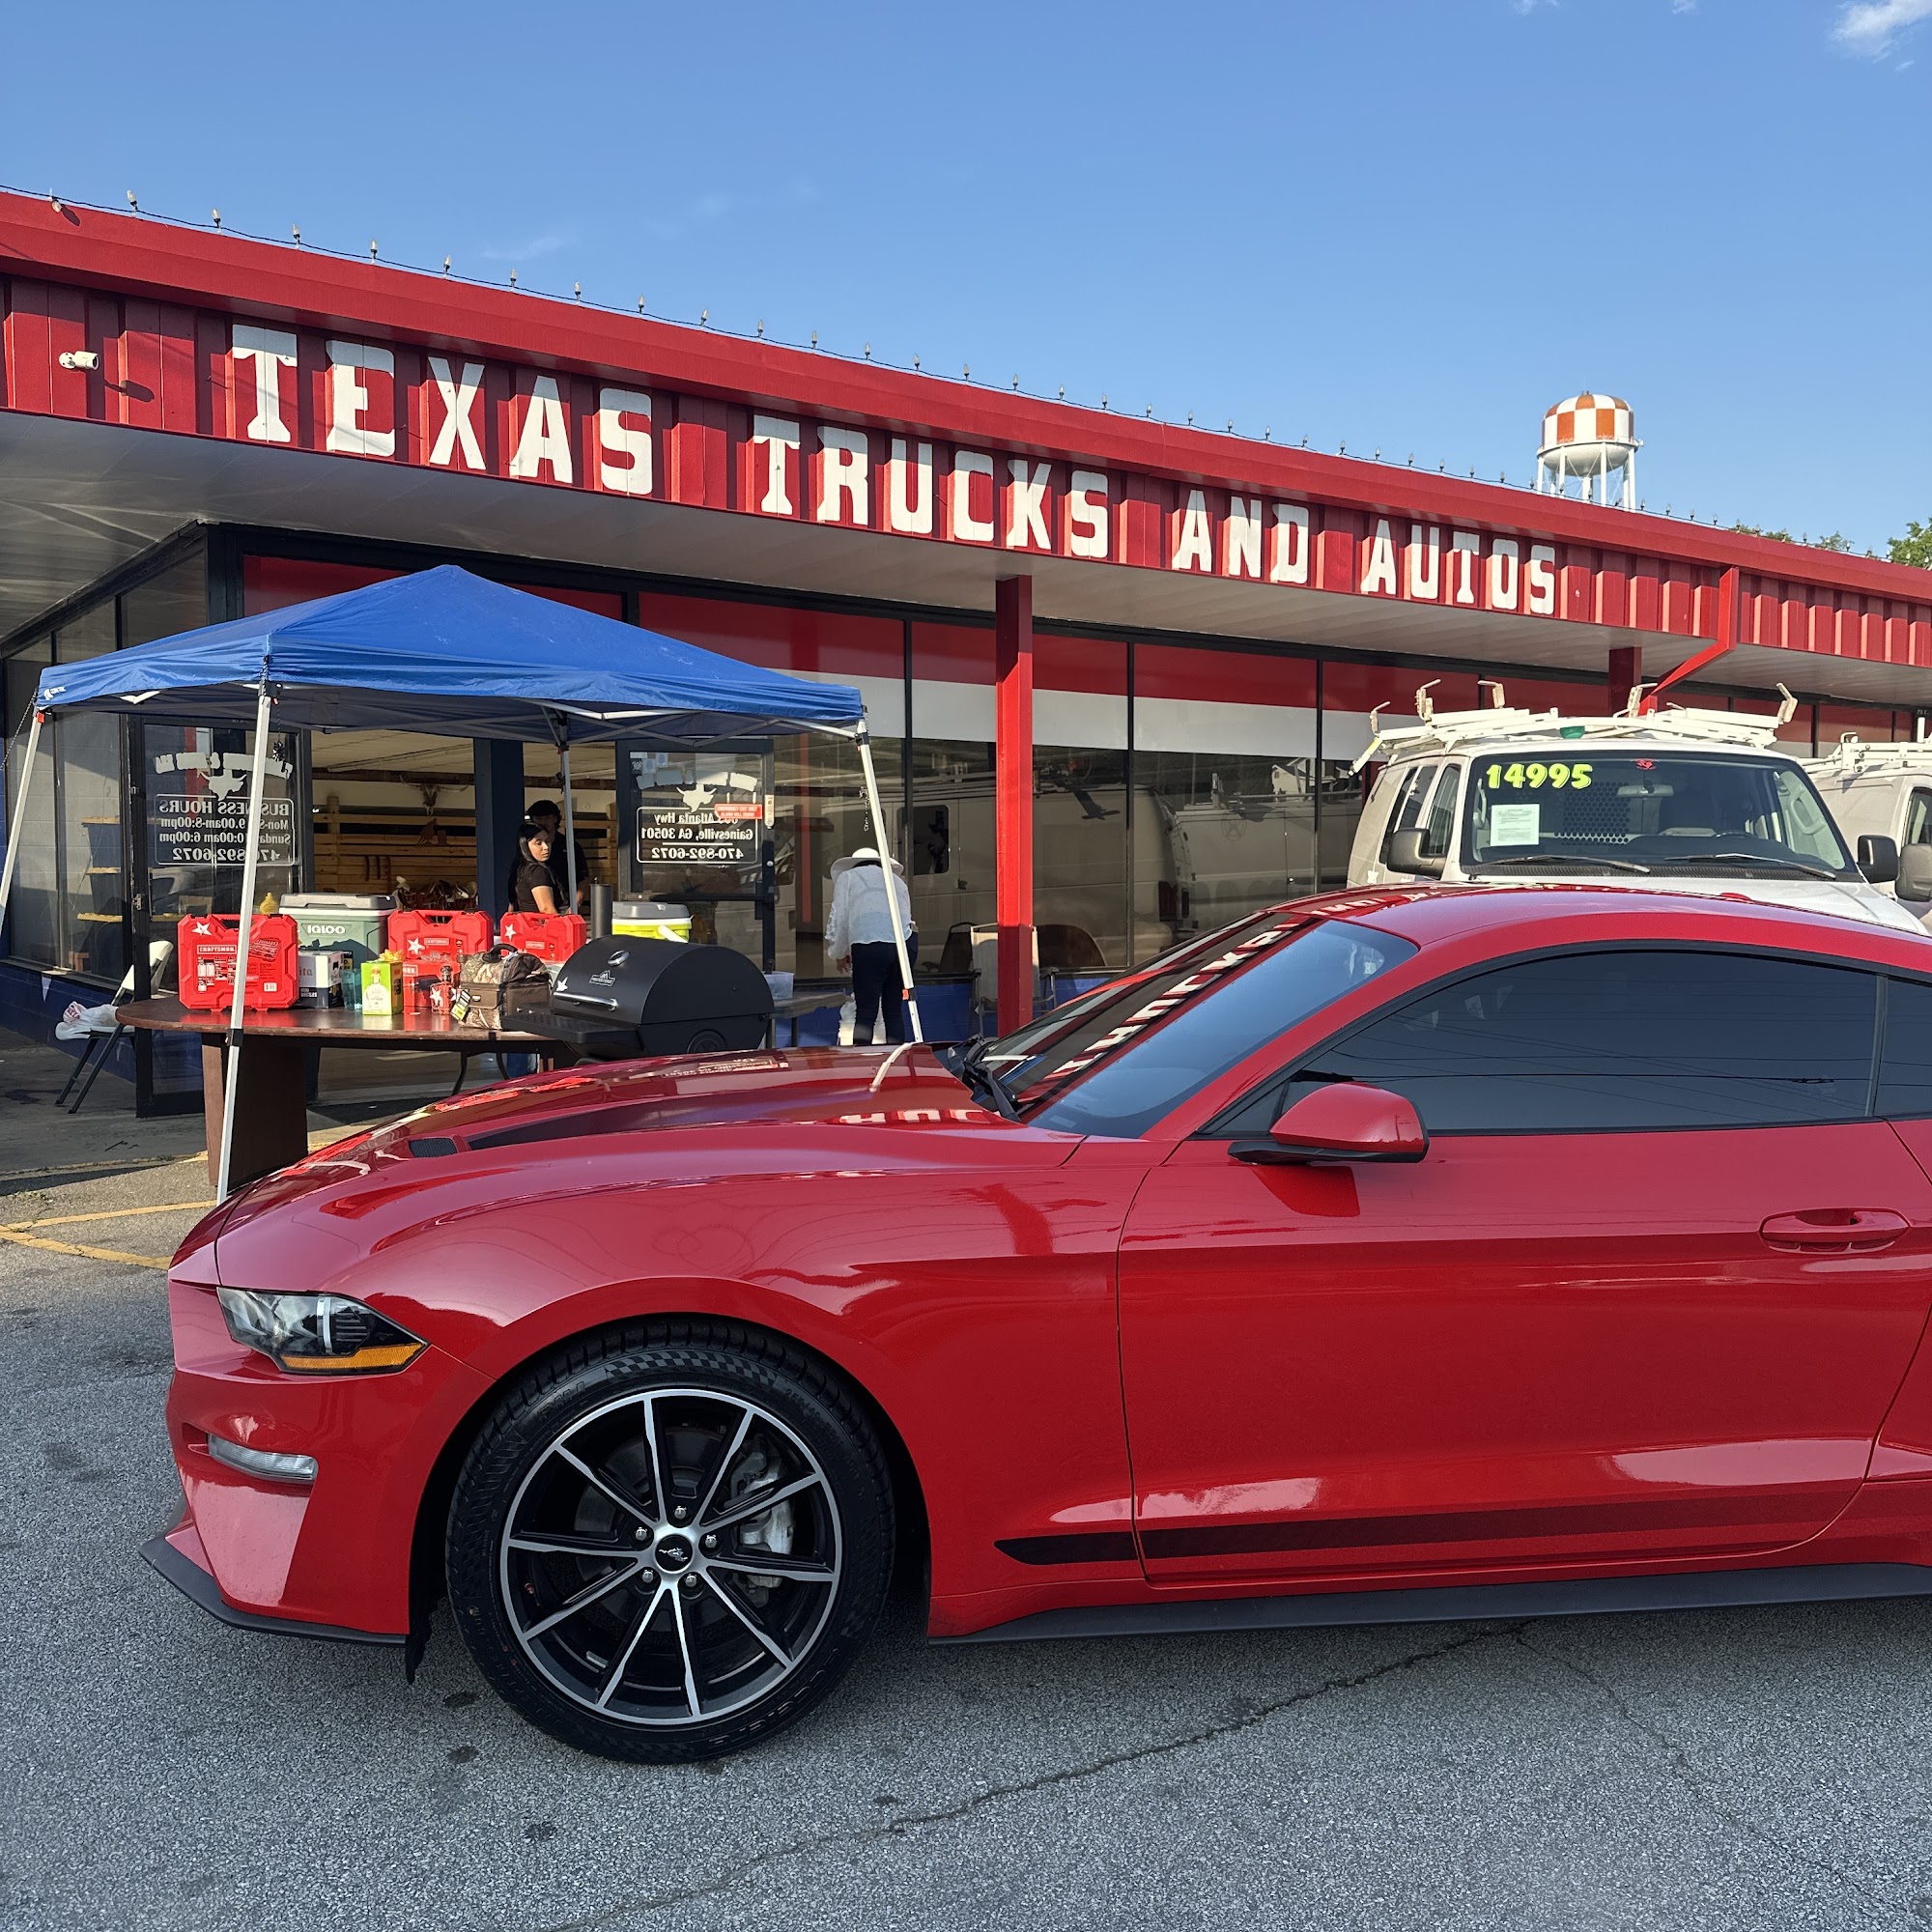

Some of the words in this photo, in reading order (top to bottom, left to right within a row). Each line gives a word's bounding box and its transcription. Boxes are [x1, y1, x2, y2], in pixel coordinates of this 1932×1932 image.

[231, 324, 653, 497] TEXAS
[753, 414, 1109, 559] TRUCKS
[1172, 489, 1310, 585] AND
[1360, 518, 1556, 615] AUTOS
[1486, 762, 1593, 789] 14995
[307, 924, 346, 934] IGLOO
